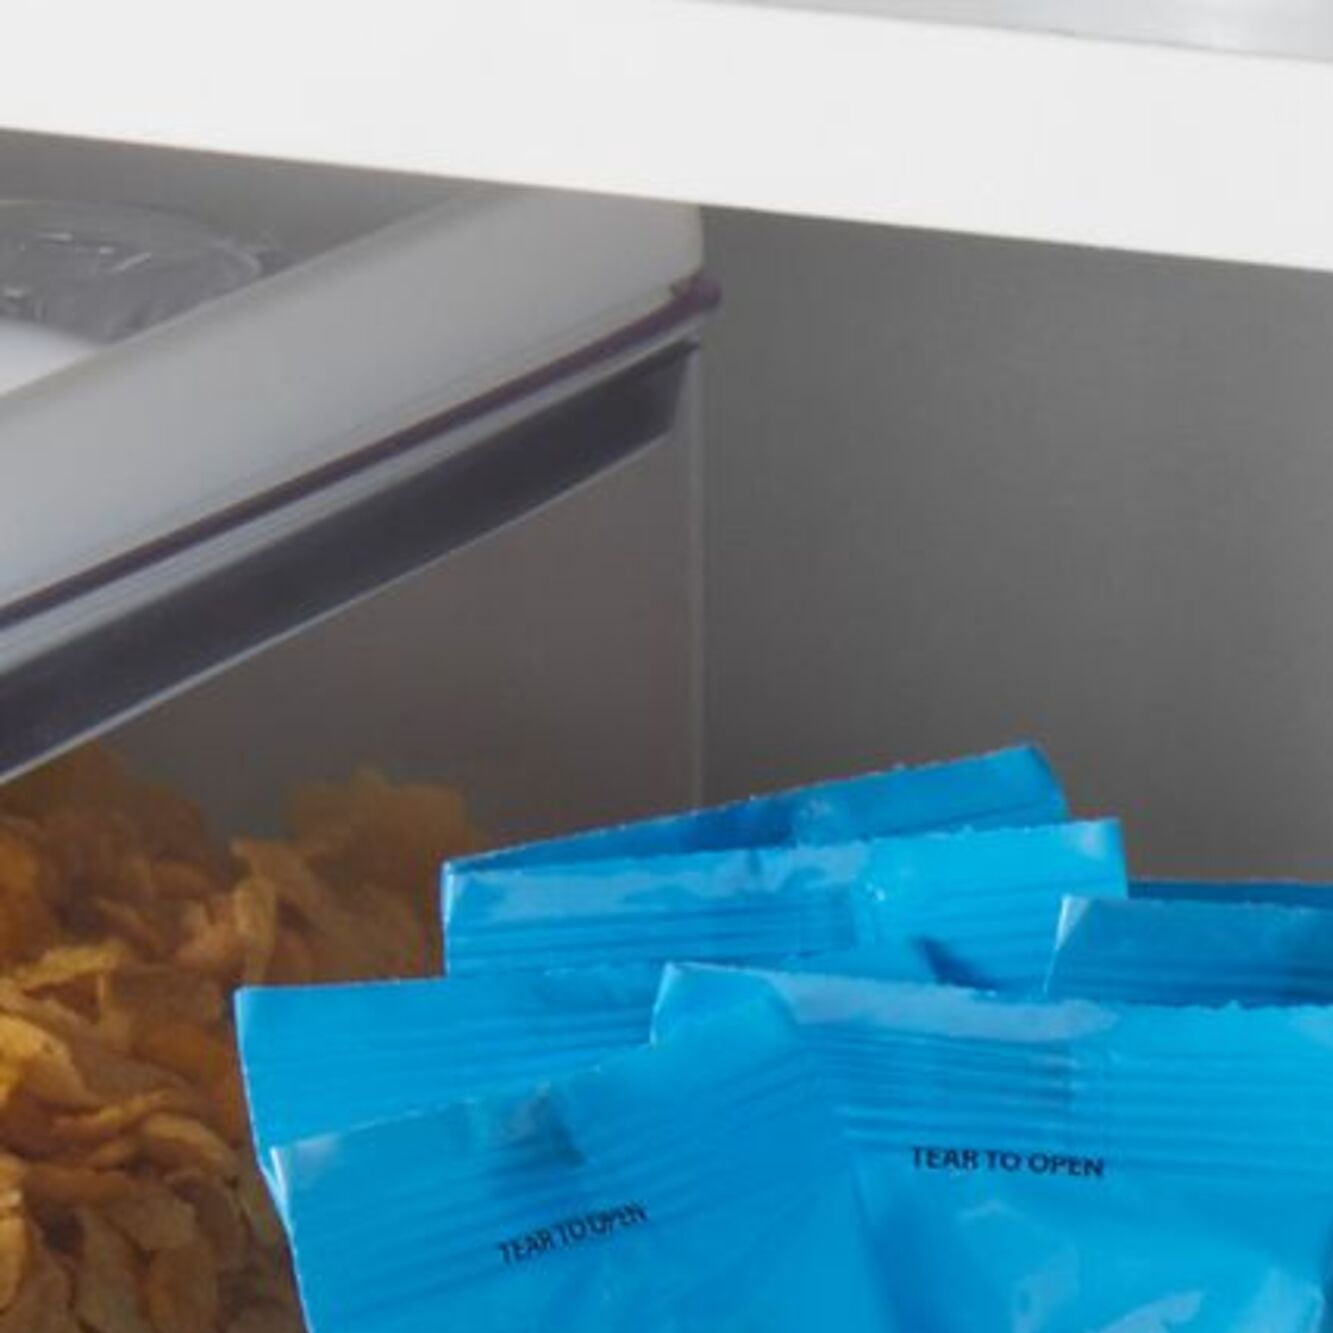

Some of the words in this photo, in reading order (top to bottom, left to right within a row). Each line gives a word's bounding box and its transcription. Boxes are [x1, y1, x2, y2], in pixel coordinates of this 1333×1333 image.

[911, 1146, 979, 1171] TEAR
[984, 1149, 1022, 1173] TO
[1026, 1152, 1105, 1178] OPEN
[498, 1228, 555, 1265] TEAR
[552, 1217, 588, 1245] TO
[584, 1200, 650, 1236] OPEN
